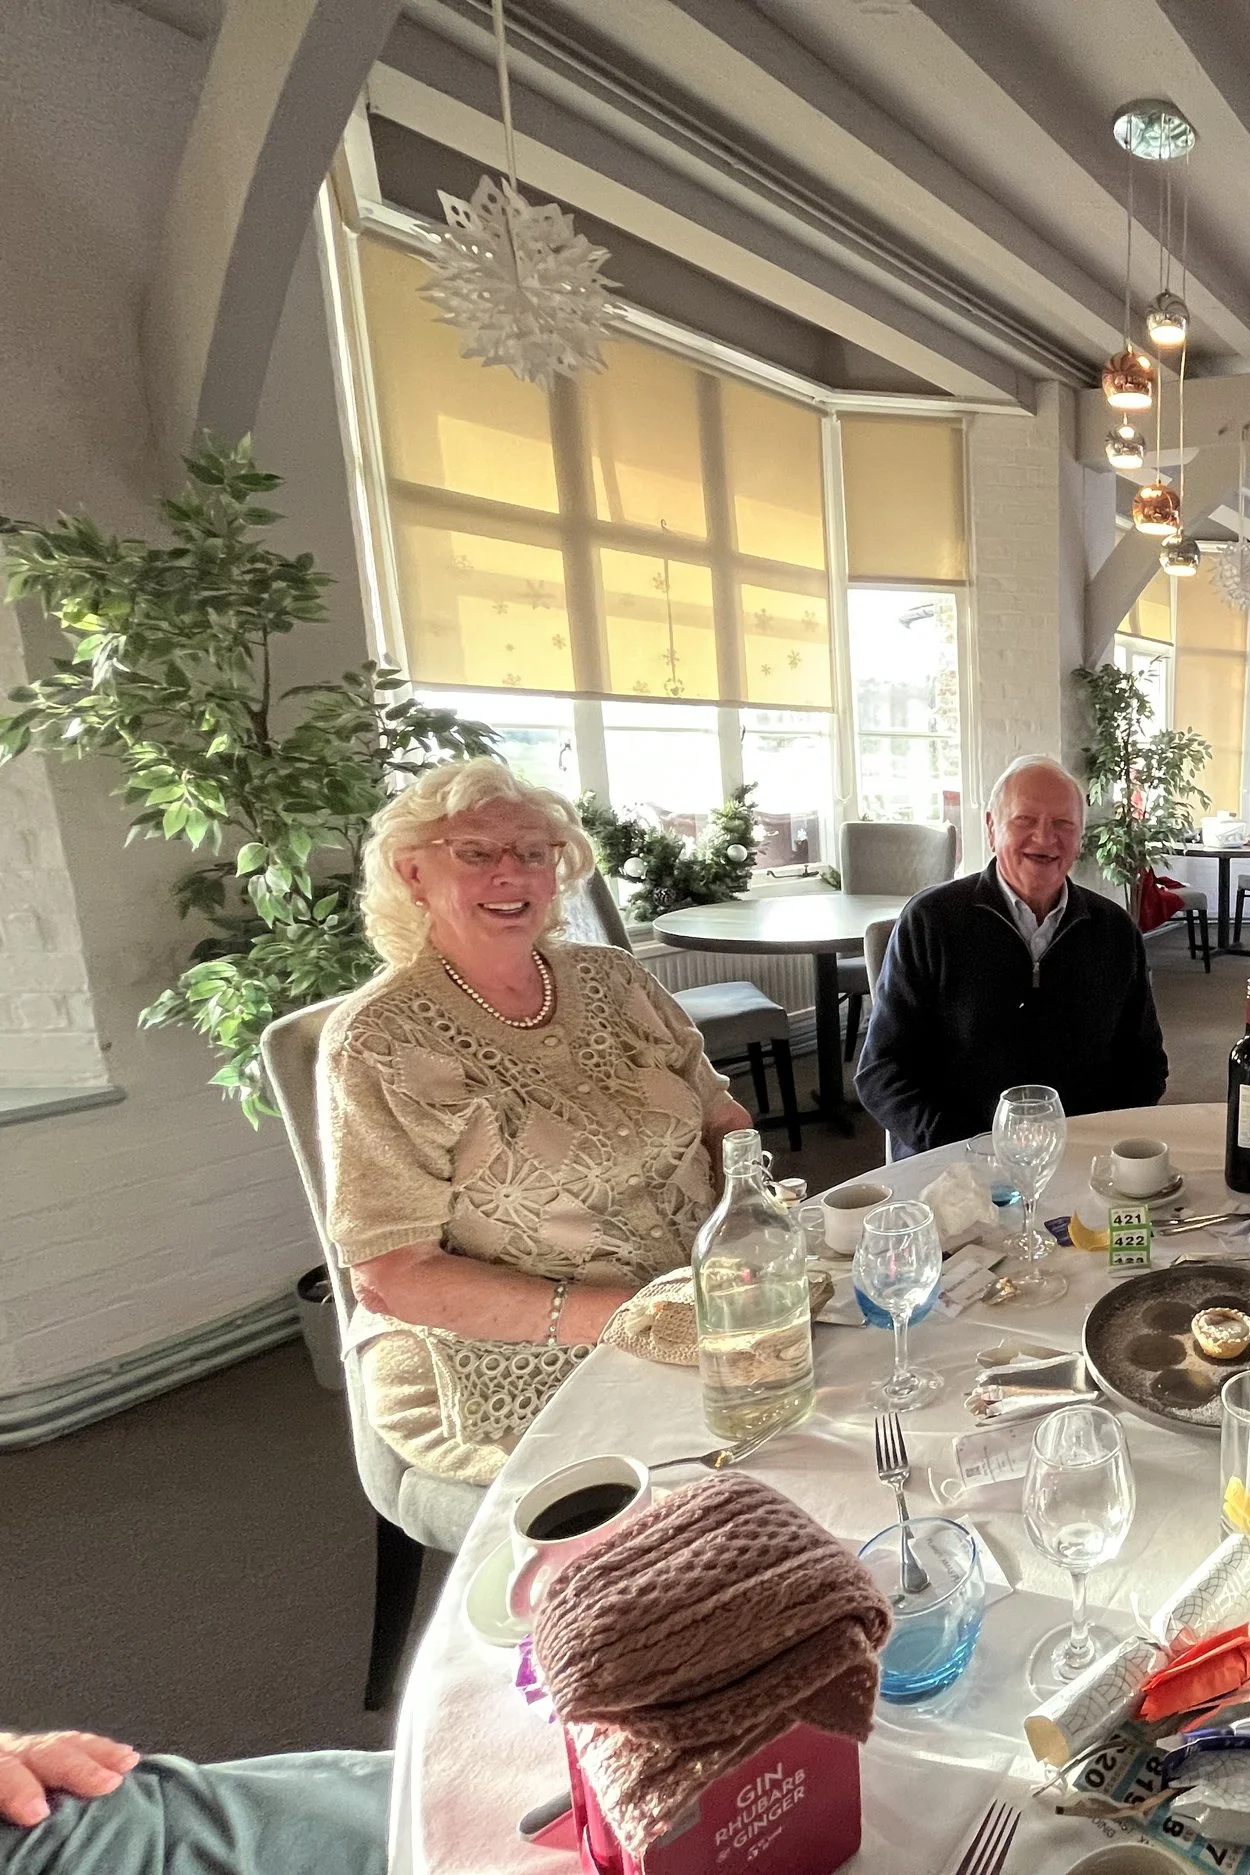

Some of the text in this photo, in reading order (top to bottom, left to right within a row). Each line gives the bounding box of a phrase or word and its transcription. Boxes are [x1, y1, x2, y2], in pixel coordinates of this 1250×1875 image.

[1113, 1213, 1141, 1225] 421
[1114, 1235, 1145, 1247] 422
[715, 1768, 806, 1846] RHUBARB
[737, 1762, 783, 1807] GIN
[733, 1786, 805, 1847] GINGER
